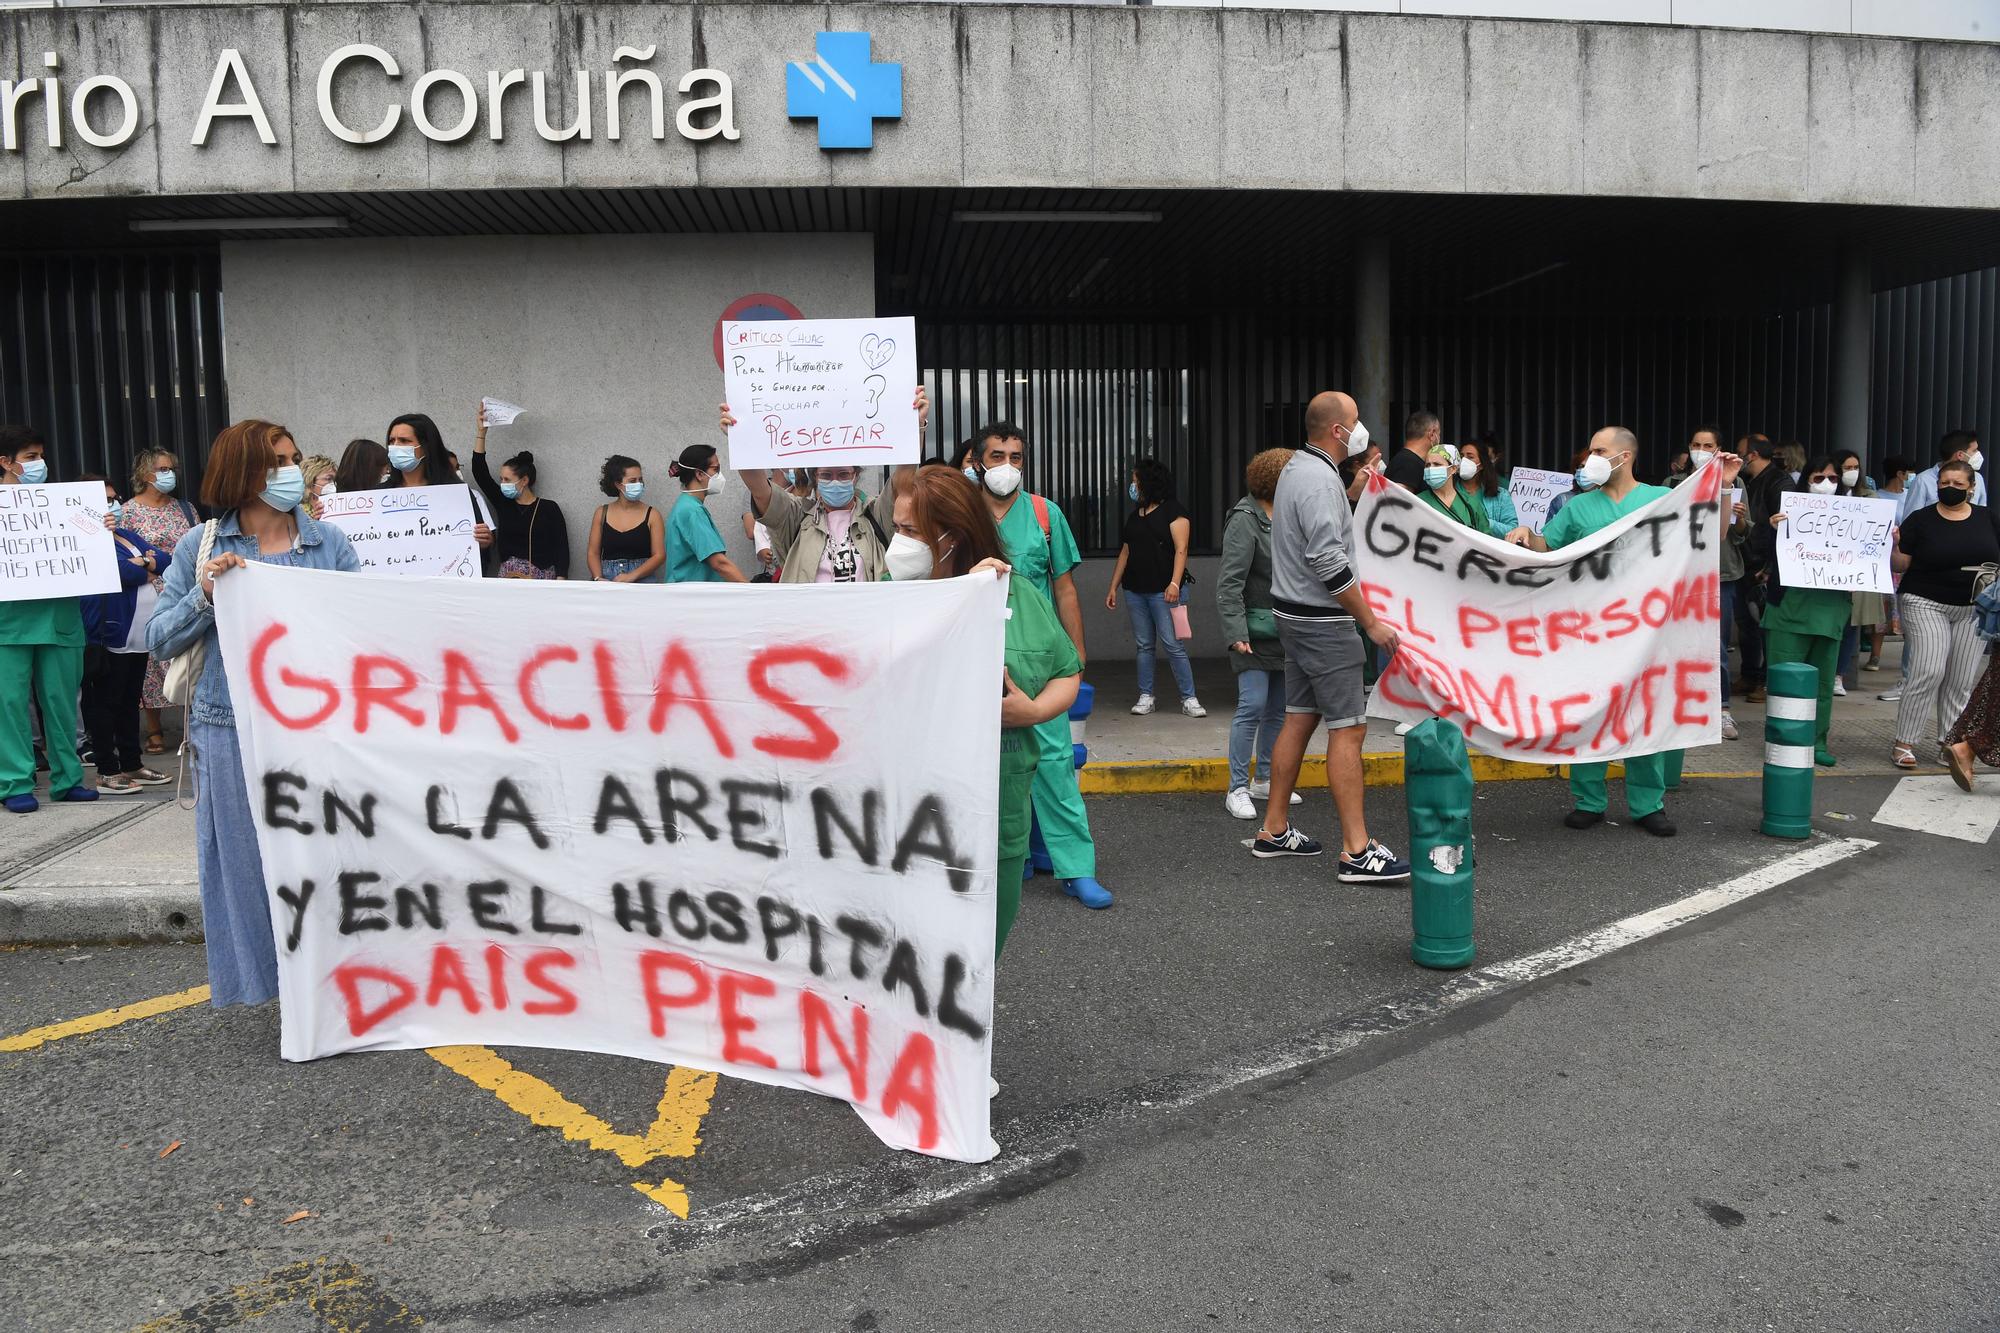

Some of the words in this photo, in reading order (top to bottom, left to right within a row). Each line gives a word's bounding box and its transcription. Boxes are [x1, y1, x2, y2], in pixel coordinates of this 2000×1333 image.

[1, 52, 138, 149] rio
[191, 49, 277, 145] A
[316, 43, 741, 144] Coruña
[763, 414, 885, 449] RESPETAR
[1365, 500, 1719, 587] GERENTE
[1361, 580, 1437, 644] EL
[1457, 571, 1721, 657] PERSONAL
[248, 622, 848, 761] GRACIAS
[263, 771, 377, 838] EN
[425, 778, 549, 849] LA
[594, 767, 973, 891] ARENA
[338, 871, 443, 936] EN
[468, 881, 580, 937] EL
[612, 881, 986, 1039] HOSPITAL
[334, 942, 578, 1037] DAIS
[640, 949, 942, 1150] PENA
